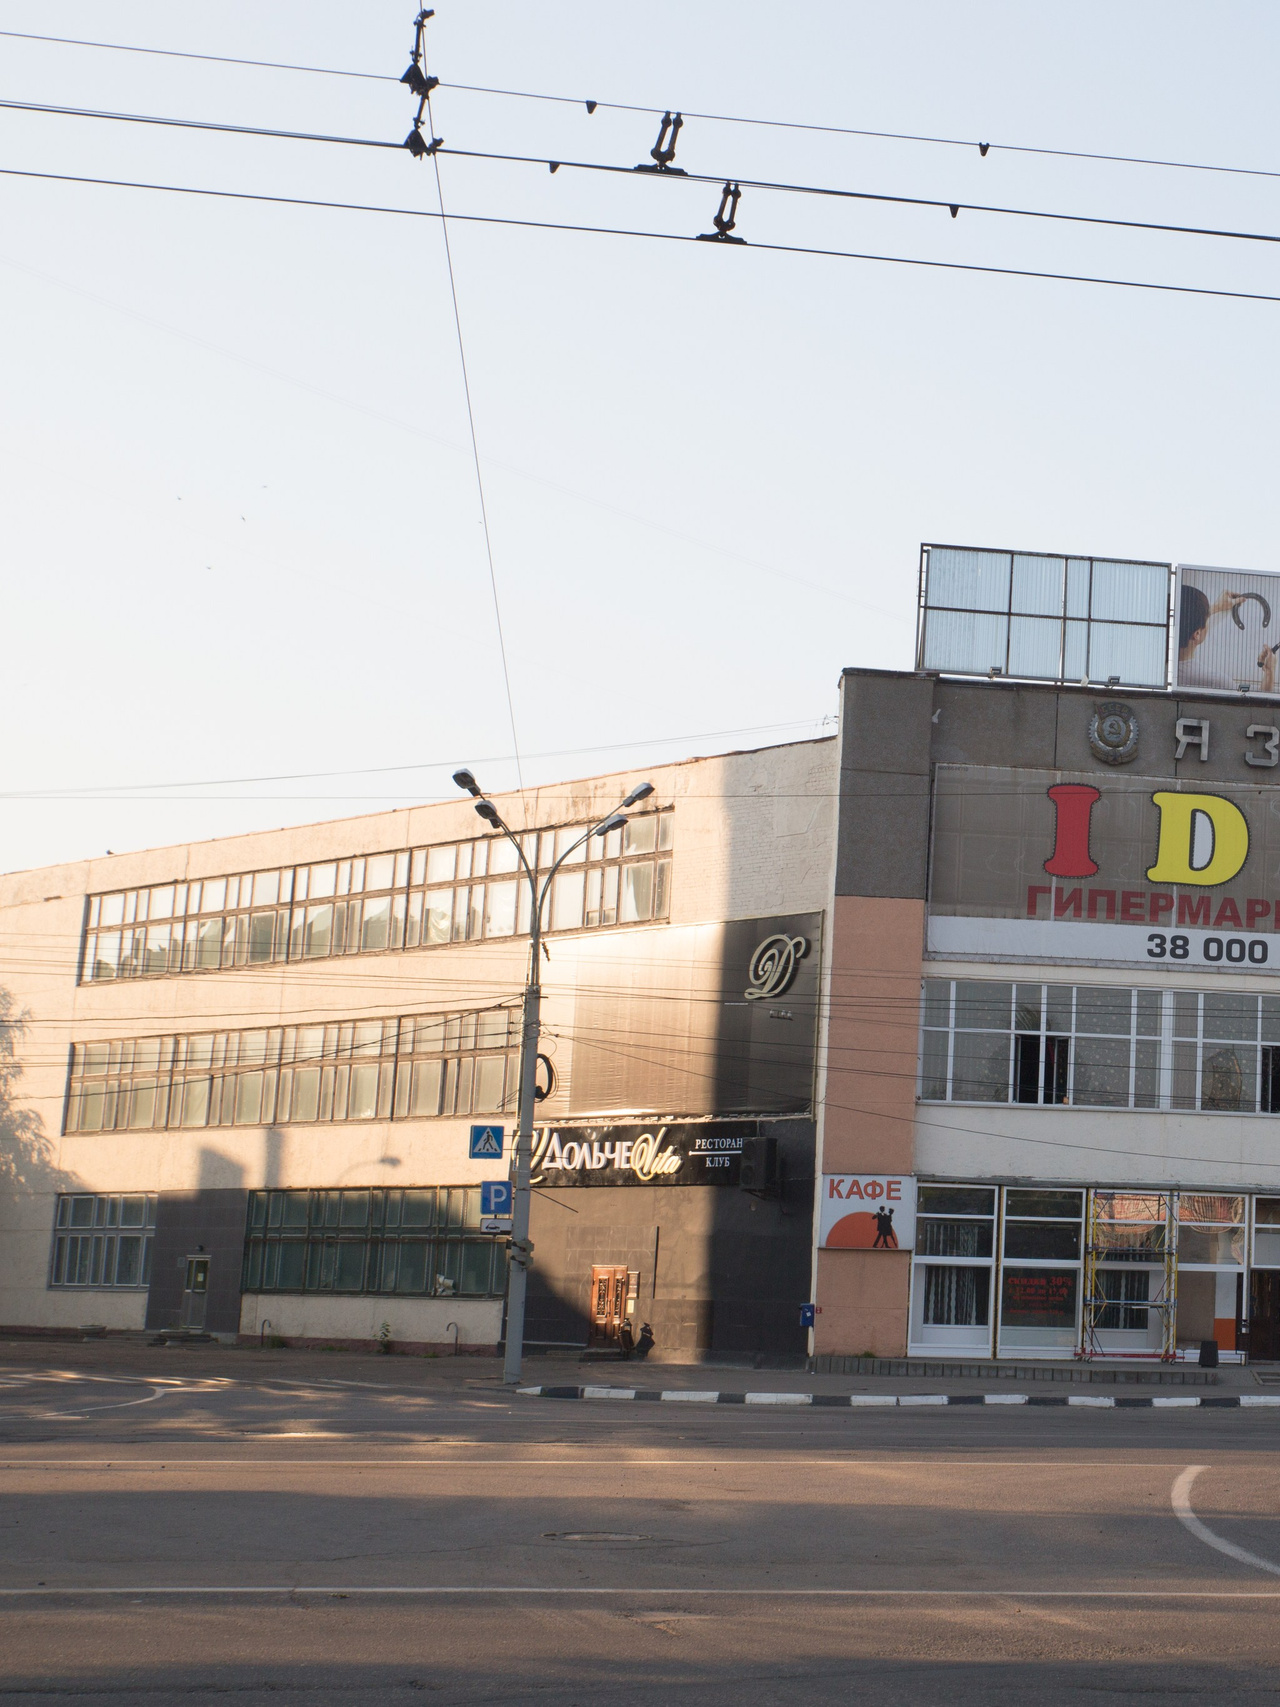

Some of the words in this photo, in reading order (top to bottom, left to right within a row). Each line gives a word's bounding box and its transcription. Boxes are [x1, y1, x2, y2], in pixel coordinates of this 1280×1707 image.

[1146, 933, 1190, 960] 38
[1203, 937, 1269, 964] 000
[695, 1137, 743, 1150] РЕСТОРАН
[706, 1156, 731, 1168] КЛУБ
[490, 1185, 507, 1211] P
[828, 1178, 902, 1201] КАФЕ
